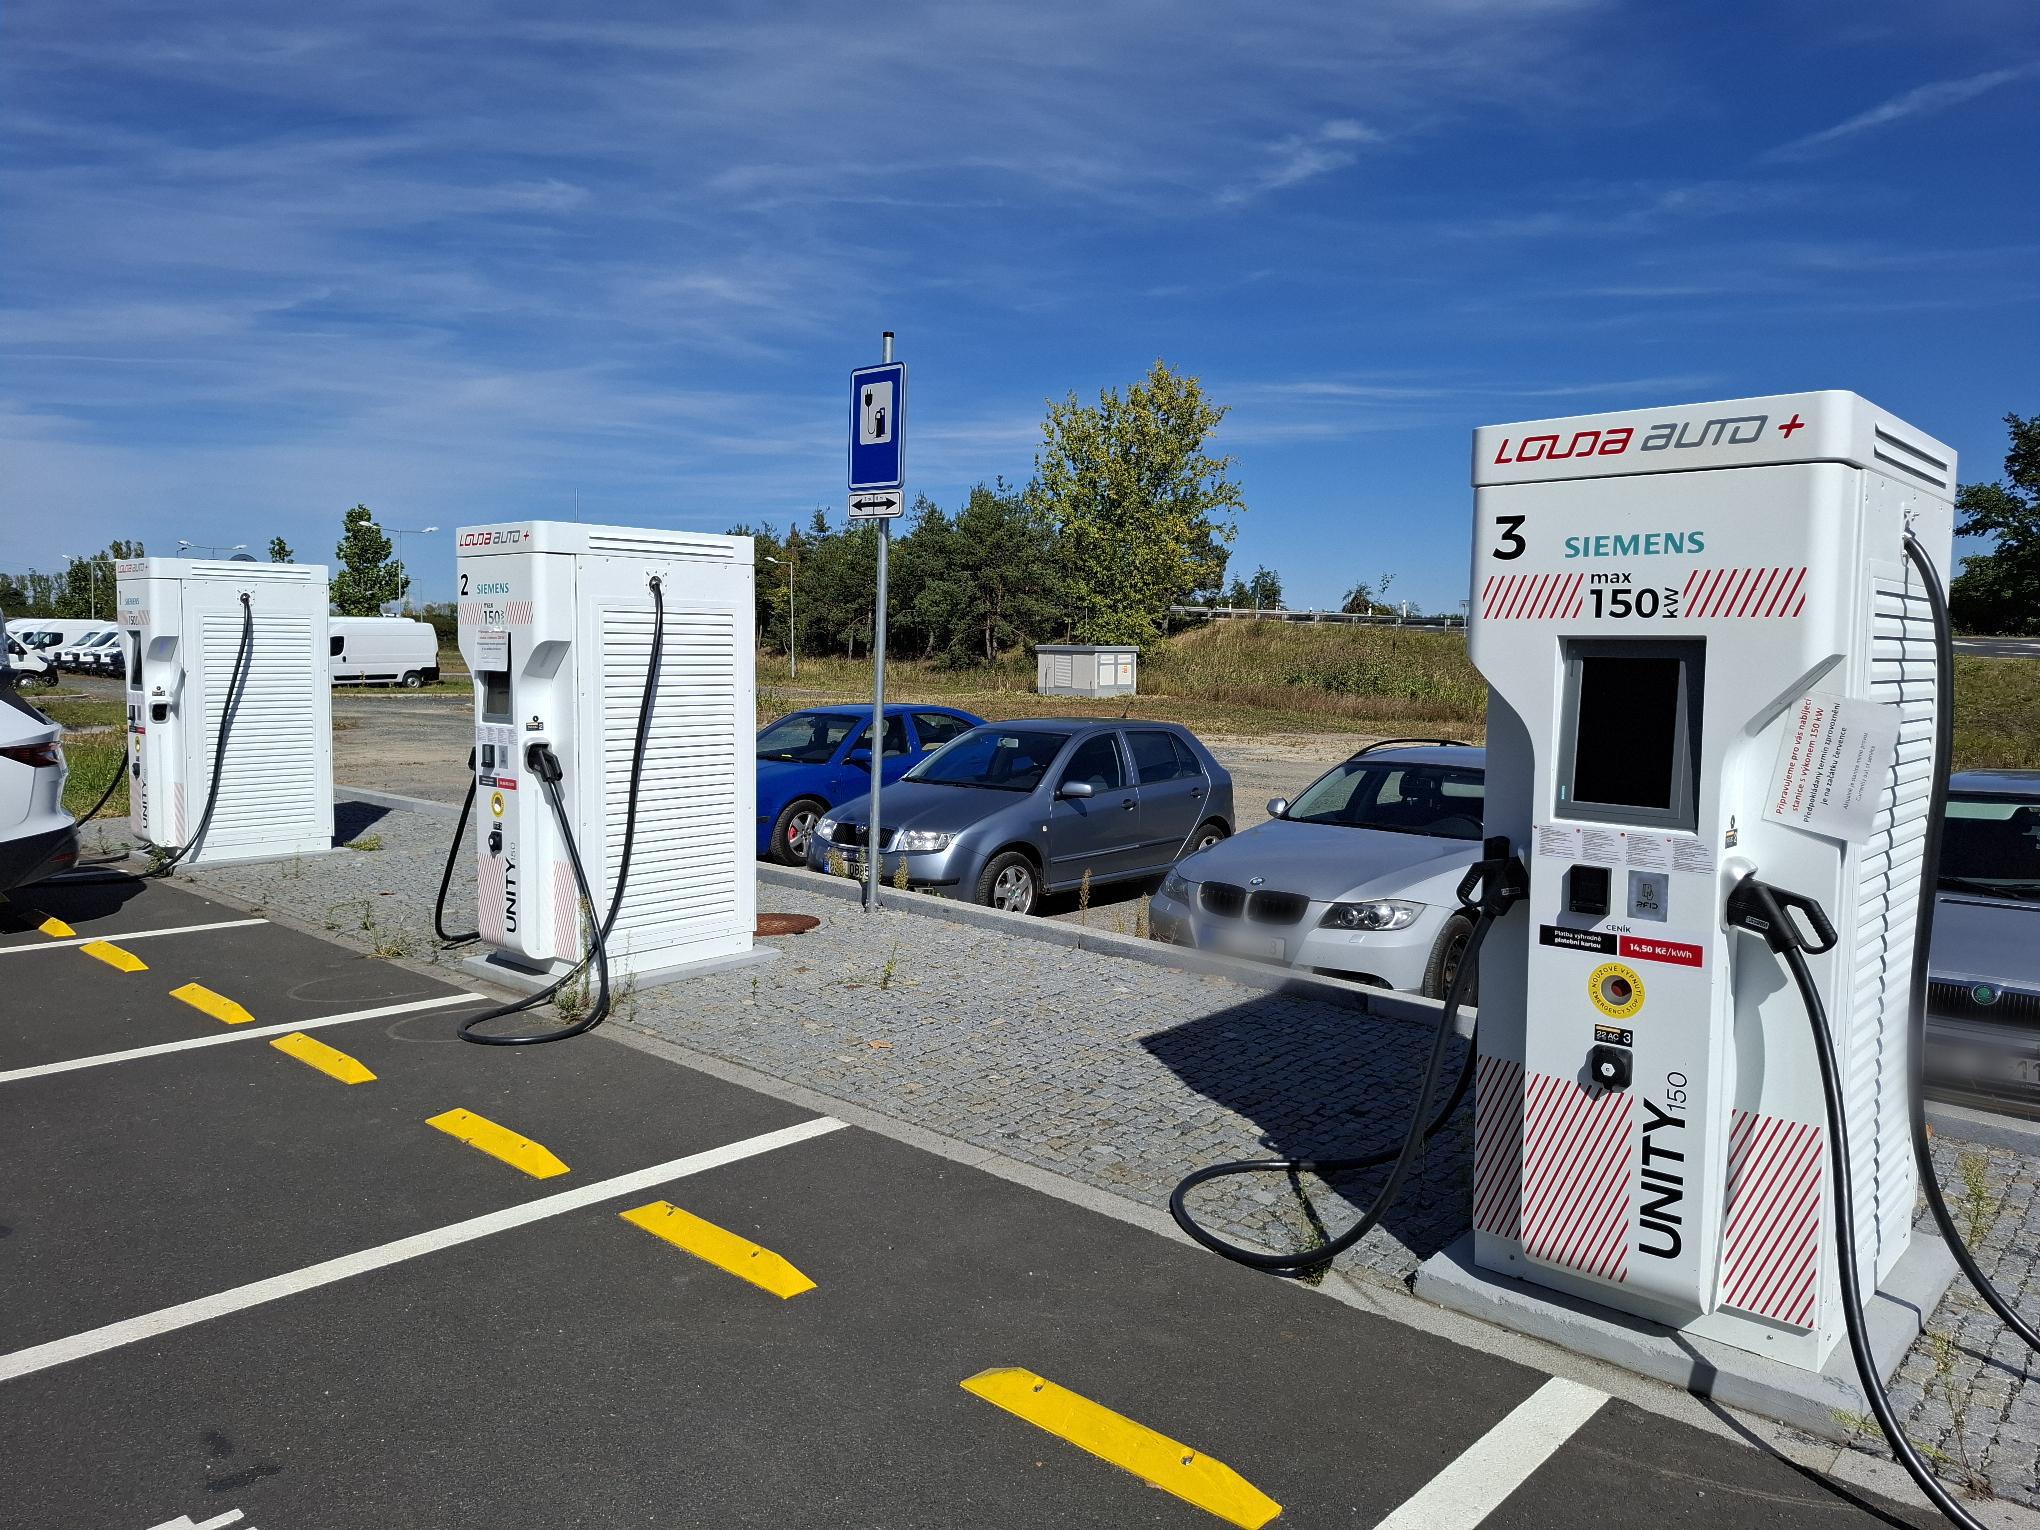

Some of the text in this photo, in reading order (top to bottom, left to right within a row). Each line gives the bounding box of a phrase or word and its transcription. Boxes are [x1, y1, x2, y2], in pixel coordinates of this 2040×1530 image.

[1778, 414, 1805, 439] +
[1492, 515, 1526, 560] 3
[1564, 531, 1705, 558] SIEMENS
[461, 574, 468, 595] 2
[477, 583, 509, 594] SIEMENS
[1590, 571, 1632, 584] max
[1590, 587, 1679, 618] 150 kW
[484, 611, 500, 624] 150
[1814, 708, 1824, 721] kW
[1825, 702, 1841, 746] zprovoznění
[1810, 723, 1820, 738] 150
[1776, 761, 1796, 814] Připravujeme
[1795, 731, 1803, 744] vás
[1800, 697, 1812, 730] nabíjecí
[1801, 741, 1815, 775] výkonem
[1820, 797, 1828, 805] je
[1828, 761, 1838, 786] začátku
[1834, 727, 1847, 759] července
[1793, 784, 1805, 811] stanice
[505, 856, 516, 932] UNITY
[1636, 901, 1658, 909] RFID
[1574, 933, 1601, 942] výhradně
[1606, 924, 1631, 933] CENÍK
[1629, 943, 1692, 959] 14,50 Kč/kWh
[1592, 991, 1639, 1014] EMERGENCY STOP
[1623, 1032, 1631, 1043] 3
[1639, 1072, 1687, 1259] UNITY 150
